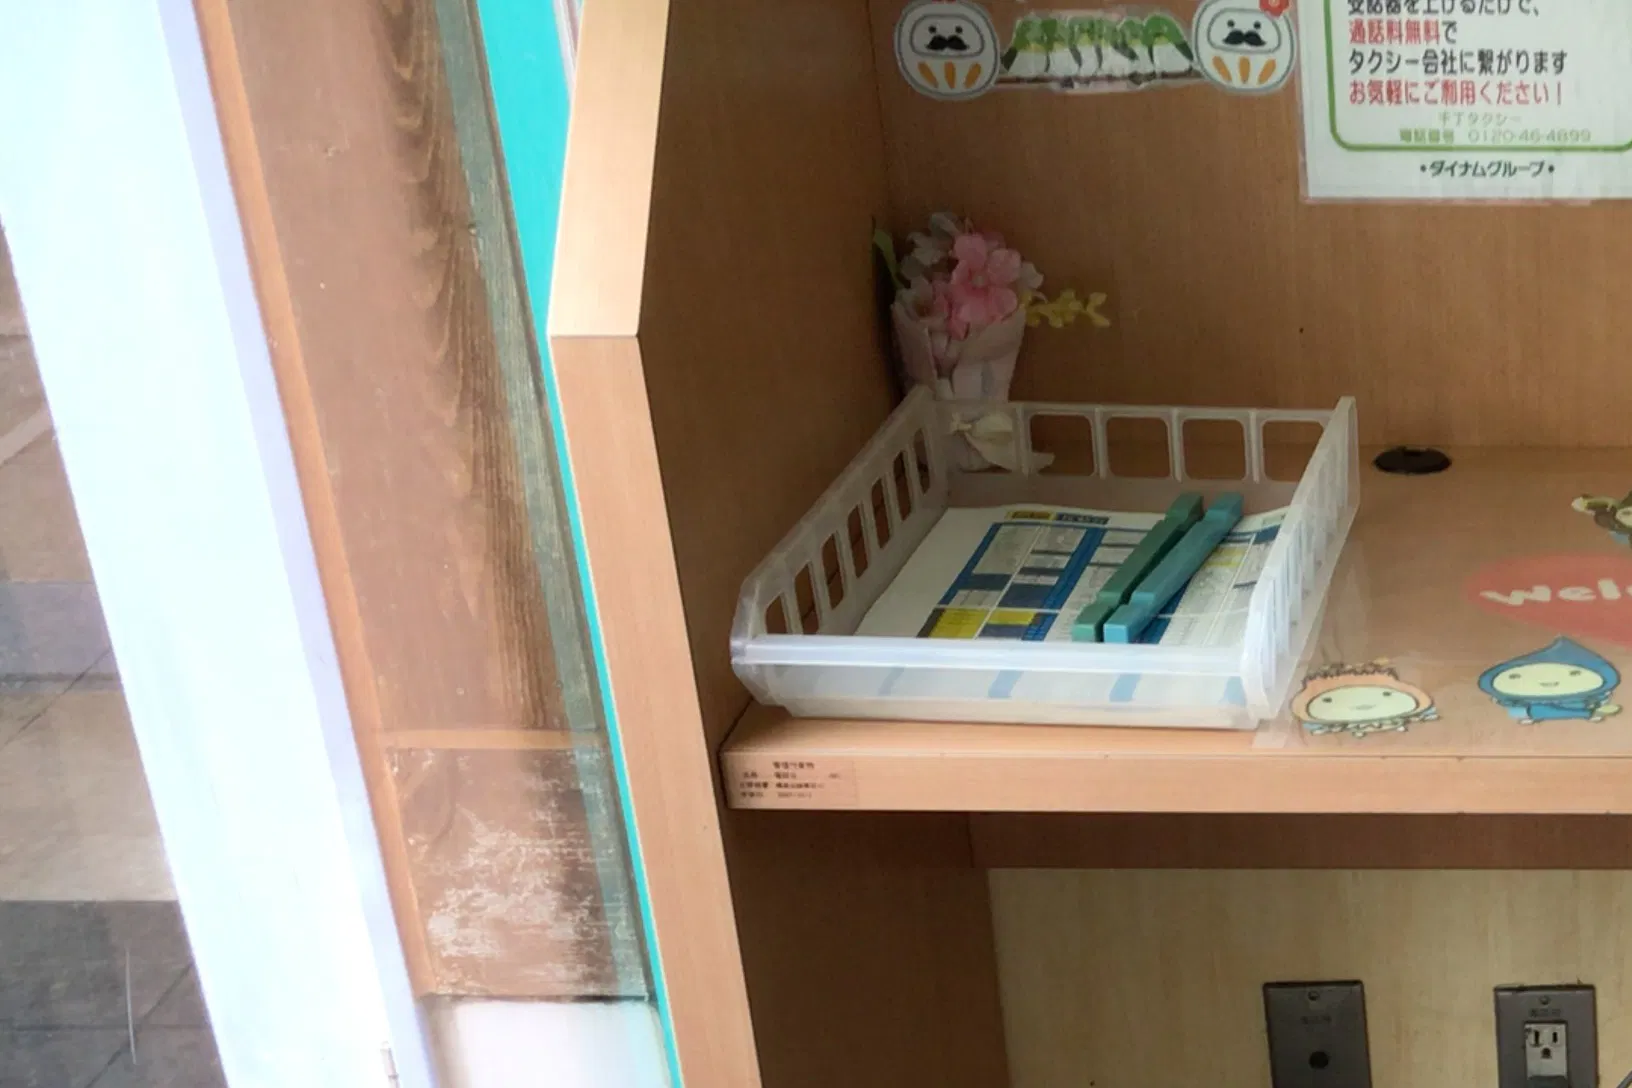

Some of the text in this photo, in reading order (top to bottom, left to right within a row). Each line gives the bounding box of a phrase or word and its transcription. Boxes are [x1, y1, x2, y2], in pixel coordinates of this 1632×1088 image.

[1349, 18, 1458, 45] 通話料無料で
[1349, 50, 1568, 75] タクシー会社に繋がります
